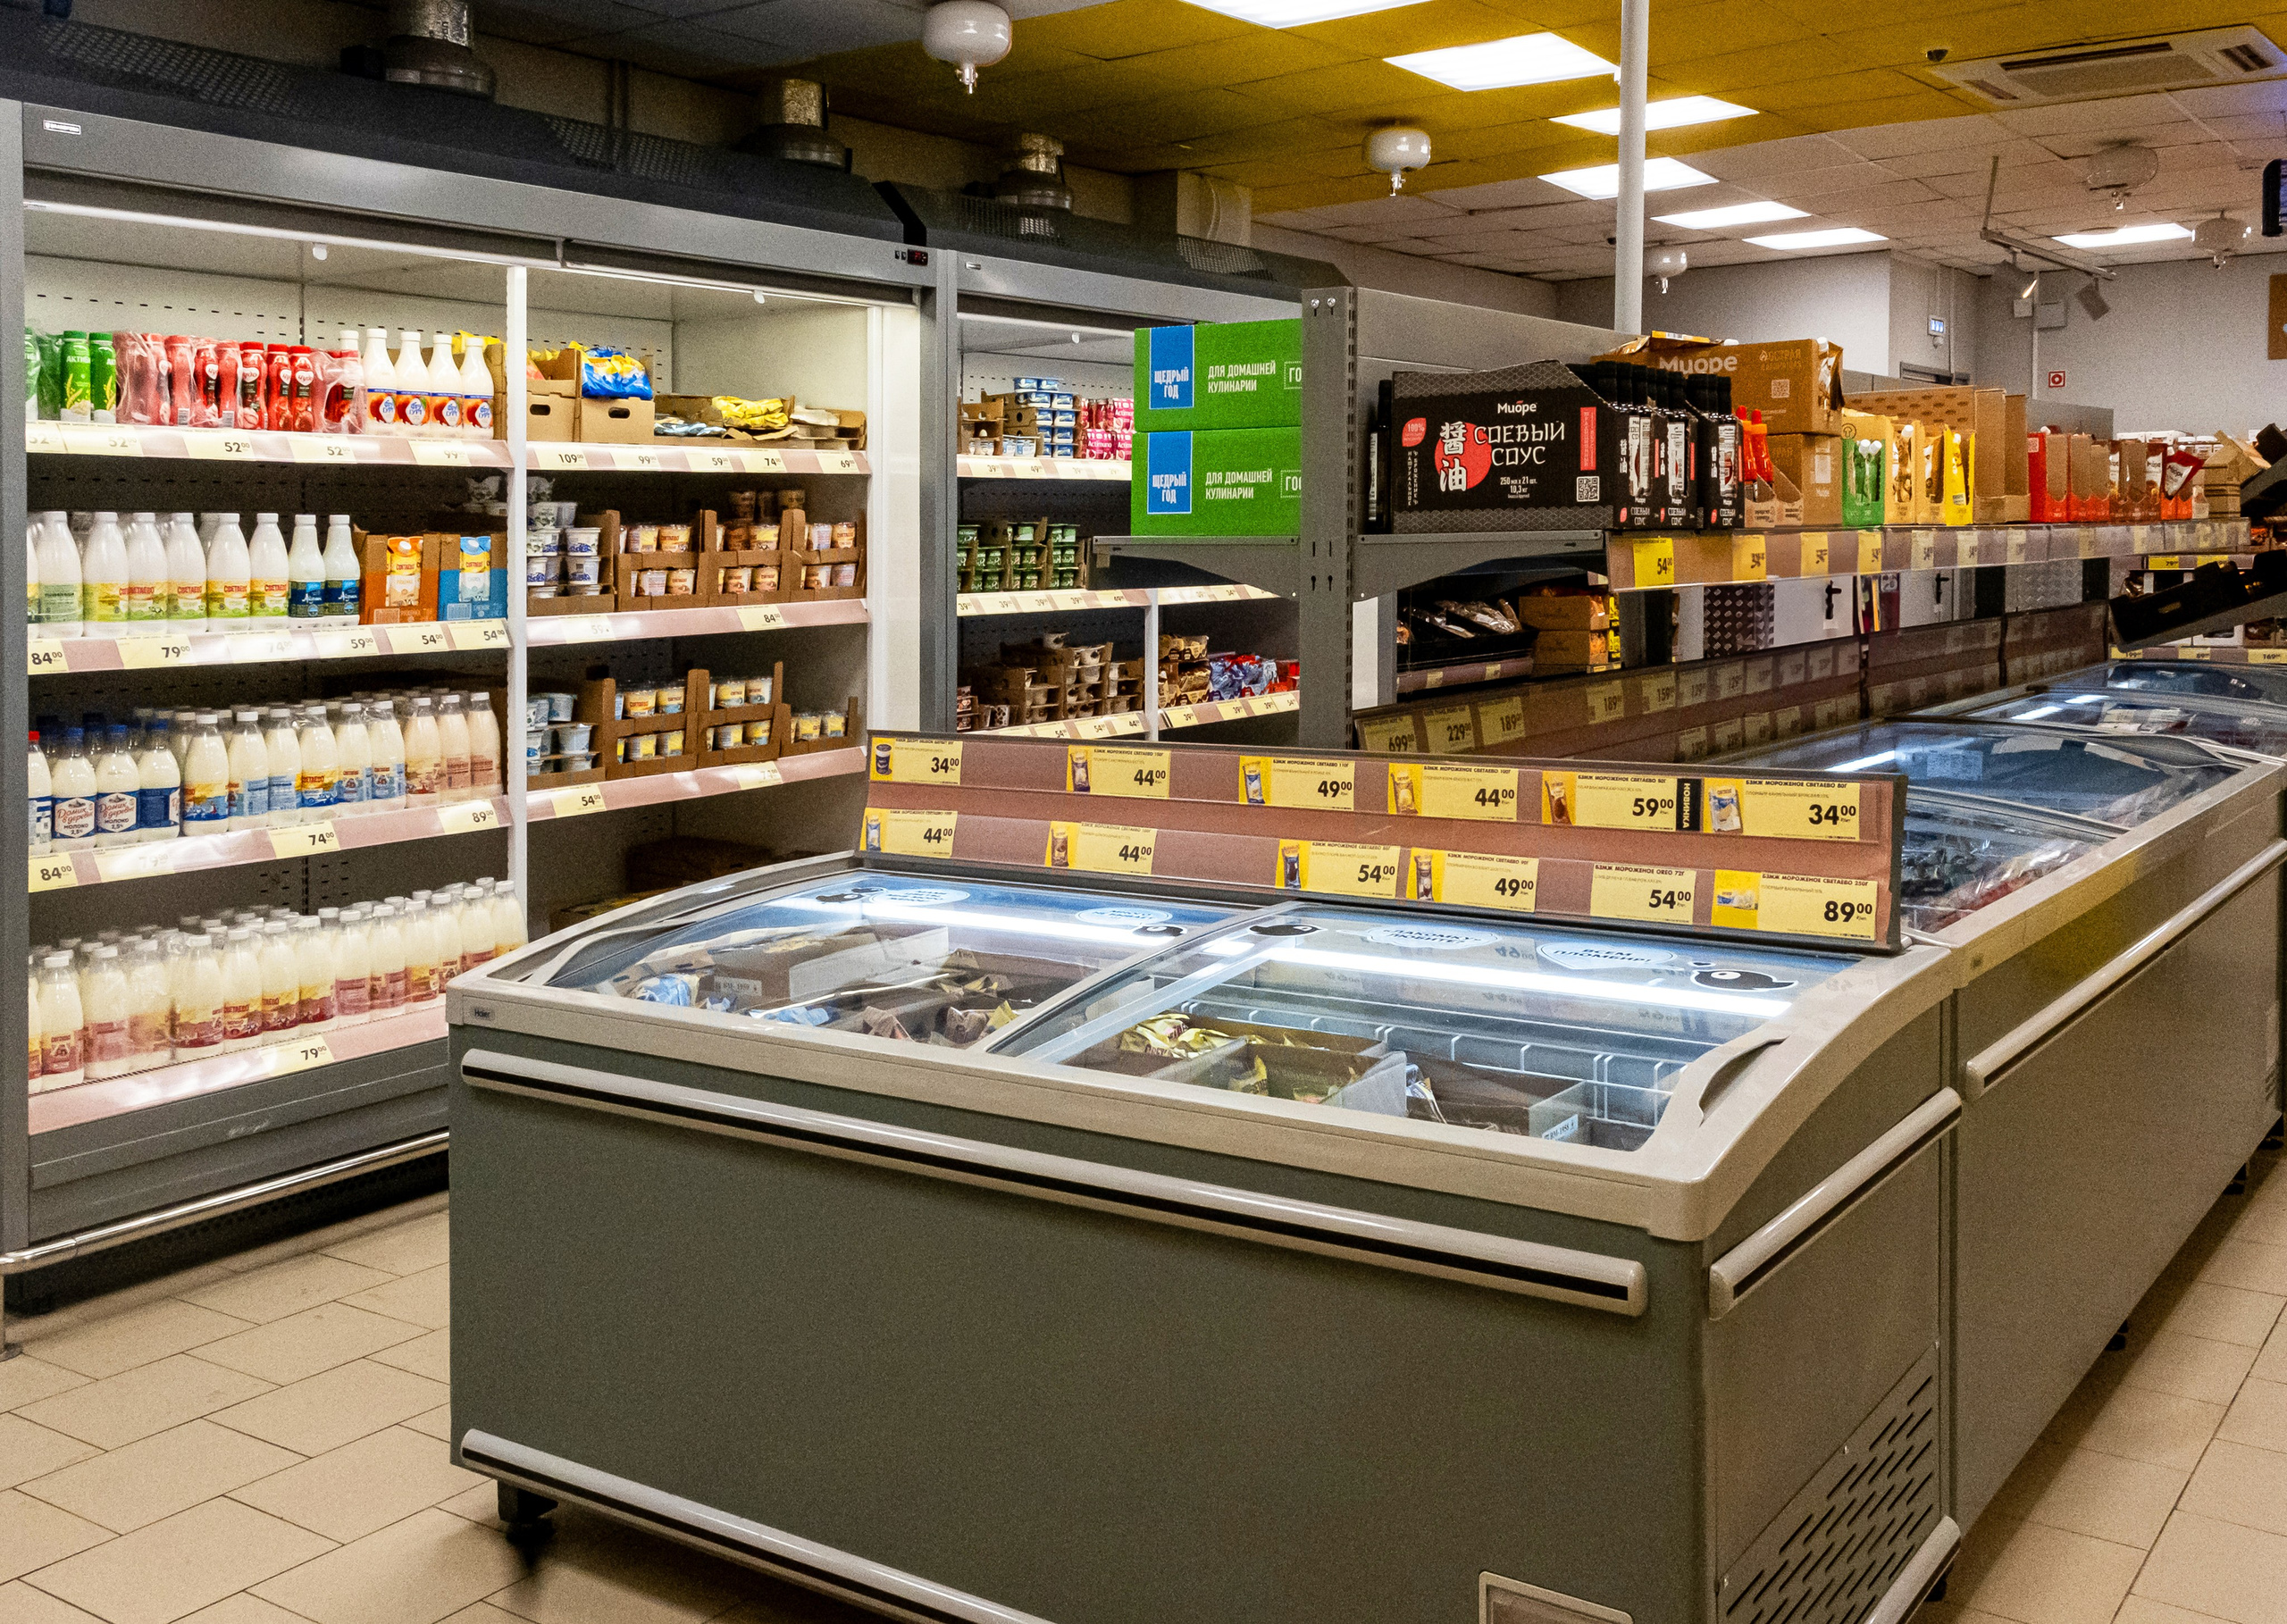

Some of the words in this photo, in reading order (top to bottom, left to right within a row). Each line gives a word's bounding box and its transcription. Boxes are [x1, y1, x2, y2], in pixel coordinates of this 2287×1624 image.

[1154, 366, 1189, 384] ЩЕДРЫЙ
[1208, 364, 1226, 380] ДЛЯ
[1227, 360, 1277, 378] ДОМАШНЕЙ
[1164, 384, 1179, 399] ГОД
[1208, 379, 1257, 394] КУЛИНАРИИ
[1474, 421, 1565, 445] СОЕВЫЙ
[1491, 446, 1546, 466] СОУС
[1152, 471, 1187, 489] ЩЕДРЫЙ
[1205, 471, 1223, 485] ДЛЯ
[1225, 468, 1273, 484] ДОМАШНЕЙ
[1161, 489, 1177, 504] ГОД
[1206, 487, 1254, 500] КУЛИНАРИИ
[1682, 783, 1691, 828] НОВИНКА
[1615, 866, 1654, 874] МОРОЖЕНОЕ
[1781, 875, 1821, 883] МОРОЖЕНОЕ
[1822, 877, 1853, 885] СВЕТАЕВО
[1582, 949, 1632, 957] ВСЕМ
